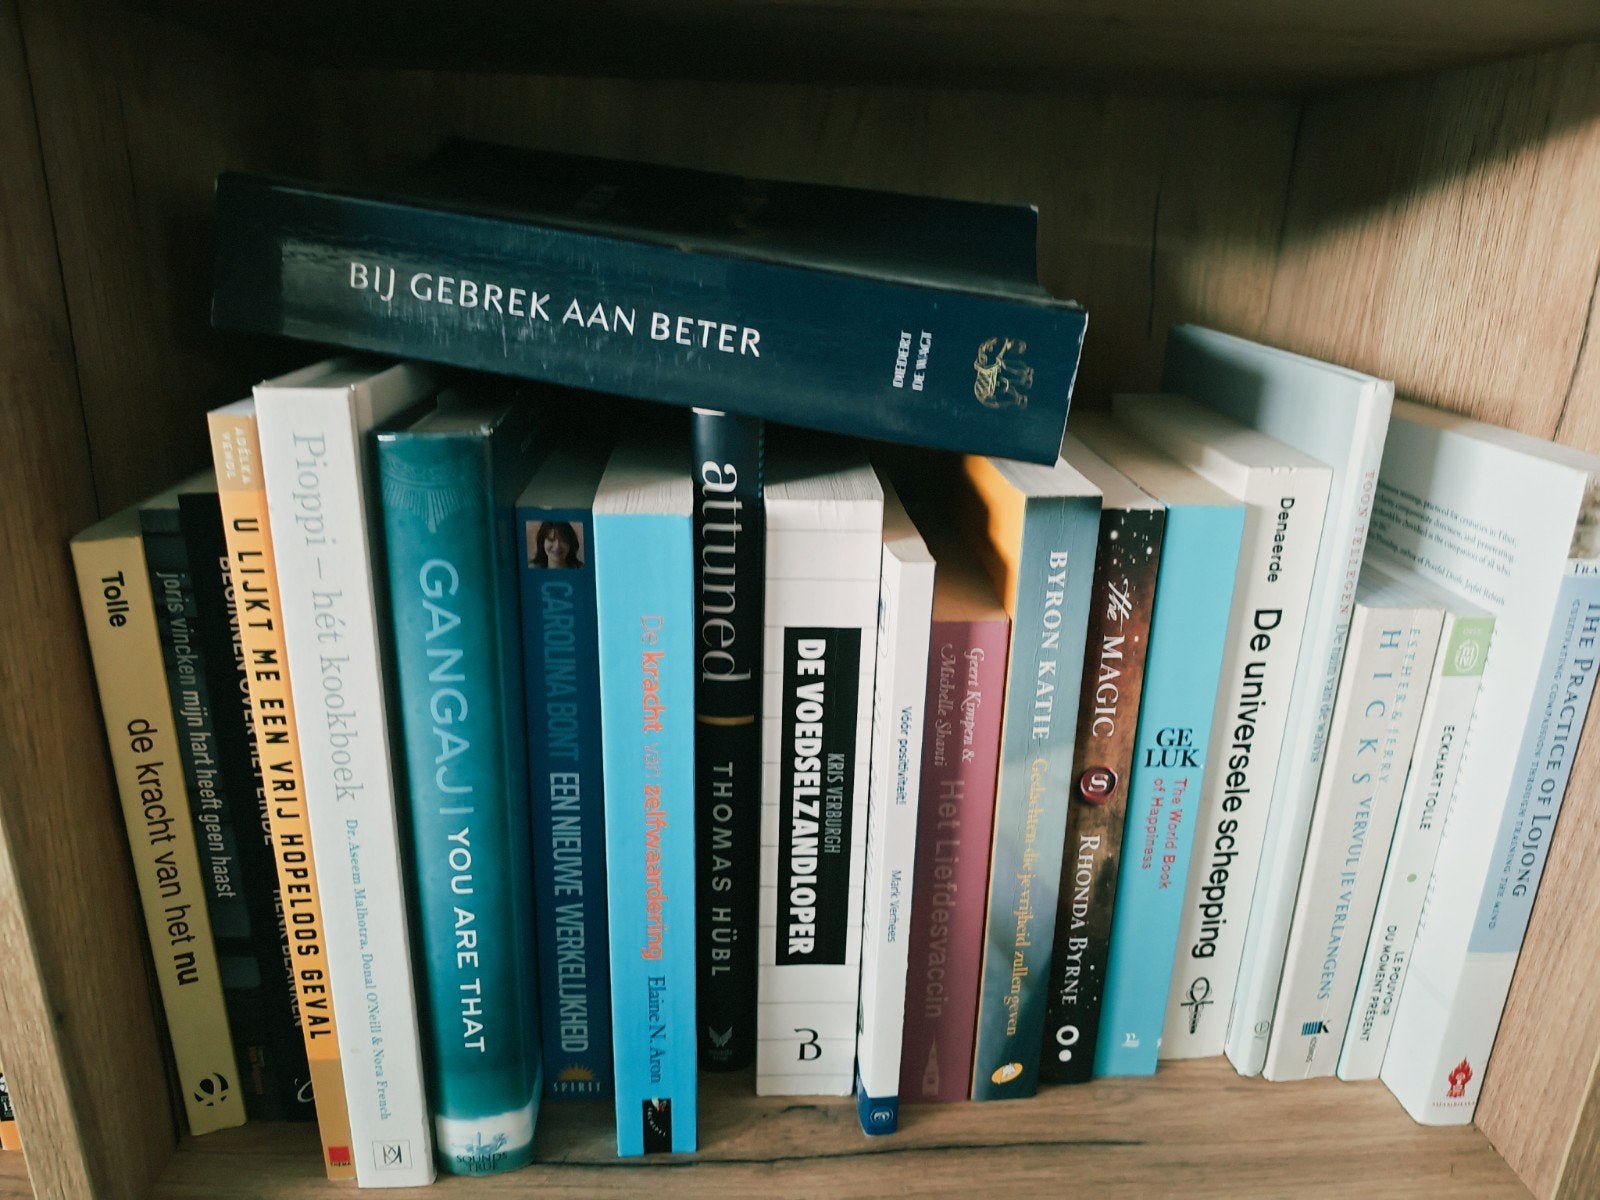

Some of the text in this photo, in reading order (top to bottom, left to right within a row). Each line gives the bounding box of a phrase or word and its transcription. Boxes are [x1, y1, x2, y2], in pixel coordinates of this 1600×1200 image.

[350, 262, 761, 358] BIJ GEBREK AAN BETER
[912, 370, 925, 391] DE
[701, 460, 750, 683] attuned
[1266, 496, 1295, 583] Denaerde
[100, 570, 130, 628] Tolle
[155, 567, 199, 686] joris vincken
[292, 428, 366, 803] Pioppi hét kookboek
[1031, 549, 1067, 741] BYRON KATIE
[936, 643, 956, 716] Michelle
[1091, 632, 1125, 739] MAGIC
[1350, 626, 1402, 787] HICKS
[1545, 655, 1593, 772] PRACTICE
[232, 515, 333, 1041] U LIJKT ME EEN VRIJ HOPELOOS GEVAL
[641, 614, 668, 959] De kracht van zelfwaardering
[961, 748, 973, 763] &
[1144, 748, 1200, 769] LUK
[1156, 727, 1193, 748] GE
[1189, 605, 1282, 961] De universele schepping
[1418, 723, 1455, 832] ECKHART TOLLE
[176, 688, 238, 899] mijn hart heeft geen haast
[345, 819, 359, 842] Dr.
[418, 556, 485, 1053] GANGAJI YOU ARE THAT
[540, 580, 589, 1052] CAROLINA BONT EEN NIEUWE WERKELIJKHEID
[786, 637, 825, 955] DE VOEDSELZANDLOPER
[822, 752, 844, 853] KRIS VERBURGH
[1140, 777, 1165, 870] of Happiness
[1158, 776, 1187, 890] The World Book
[1535, 777, 1556, 806] OF
[126, 715, 199, 986] de kracht van het nu
[348, 844, 364, 884] Aseem
[711, 761, 737, 976] THOMAS HÜBL
[923, 778, 964, 1020] Het Liefdesvaccin
[1316, 795, 1372, 1001] VERVUL JE VERLANGENS
[1510, 810, 1551, 898] LOJONG
[352, 887, 372, 949] Malhotra,
[361, 952, 377, 989] Donal
[1061, 833, 1100, 1006] RHONDA BYRNE
[1003, 995, 1019, 1035] geven
[1009, 951, 1029, 994] zullen
[1359, 924, 1396, 1041] DU MOMENT PRÉSENT
[1380, 950, 1404, 1016] LE POUVOIR
[371, 1035, 382, 1046] &
[372, 1048, 386, 1077] Nora
[648, 975, 666, 1083] Elaine N. Aron
[376, 1079, 391, 1120] French
